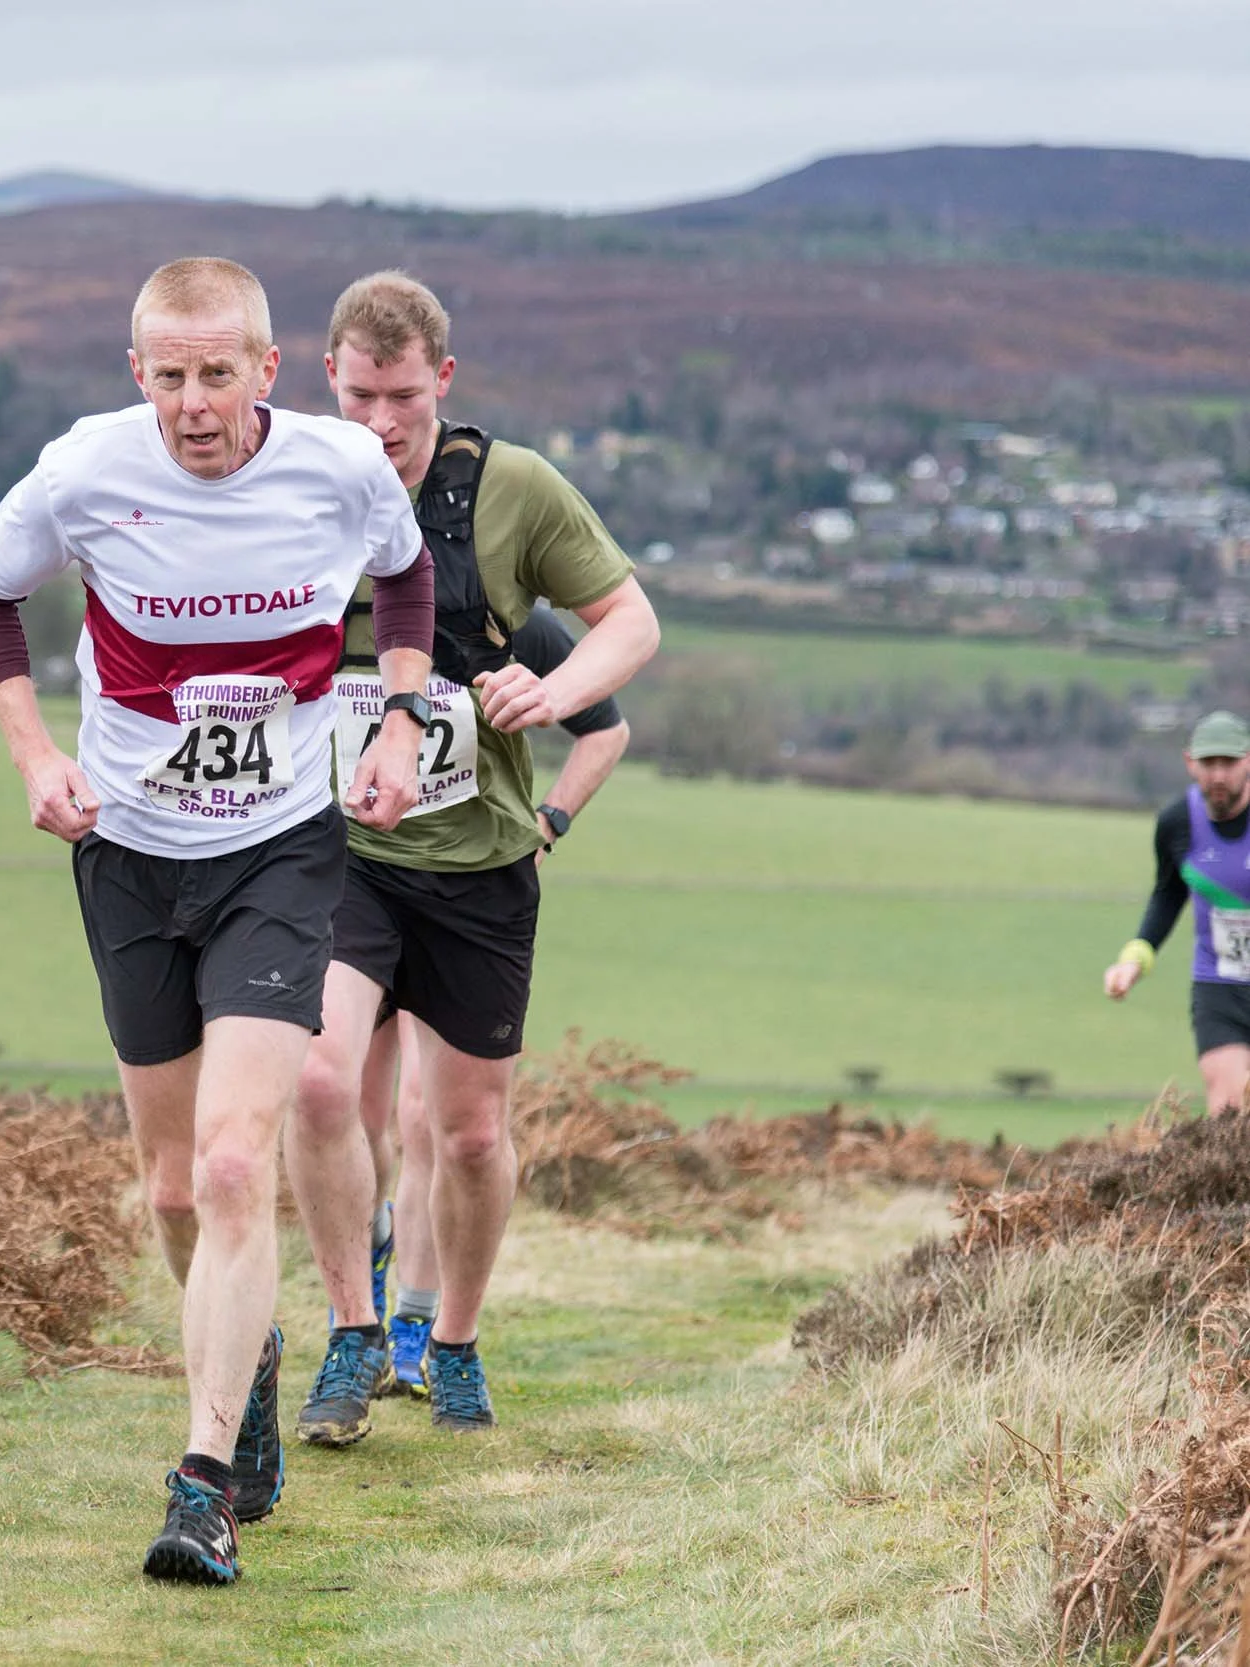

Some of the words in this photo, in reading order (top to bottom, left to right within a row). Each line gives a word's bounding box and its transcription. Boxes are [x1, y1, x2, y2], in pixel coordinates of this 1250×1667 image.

[132, 584, 316, 619] TEVIOTDALE
[174, 684, 291, 703] RTHUMBERLAN
[337, 682, 461, 699] NORTHULAND
[207, 702, 278, 722] RUNNERS
[352, 701, 382, 716] FELL
[166, 720, 273, 785] 434
[418, 769, 473, 795] LAND
[144, 778, 202, 802] PETE
[211, 787, 288, 808] BLAND
[178, 799, 250, 819] SPORTS
